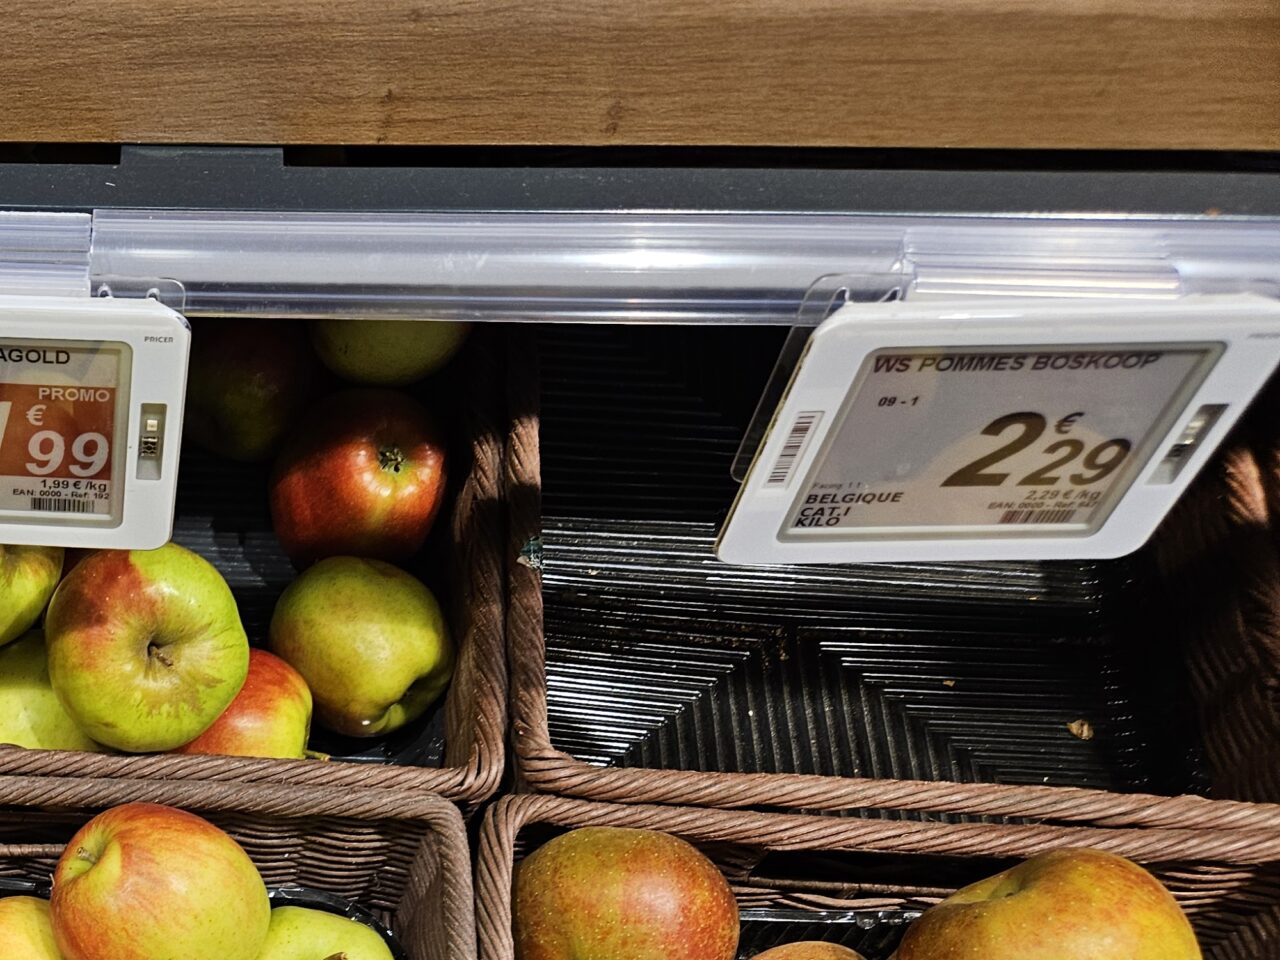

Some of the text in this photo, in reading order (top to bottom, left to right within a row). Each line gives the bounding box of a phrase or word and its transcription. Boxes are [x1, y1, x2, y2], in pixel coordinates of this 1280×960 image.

[873, 354, 1163, 373] WS POMMES BOSKOOP
[38, 387, 111, 402] PROMO
[877, 396, 897, 407] 09
[911, 396, 920, 407] 1
[25, 404, 47, 426] €
[24, 430, 110, 478] 99
[939, 411, 1132, 488] 2 € 29
[12, 488, 37, 496] EAN:
[40, 479, 107, 493] 1,99 € /kg
[805, 491, 904, 504] BELGIQUE
[1024, 489, 1102, 502] 2,29 € /kg
[800, 506, 852, 517] CAT.I
[794, 516, 841, 527] KILO
